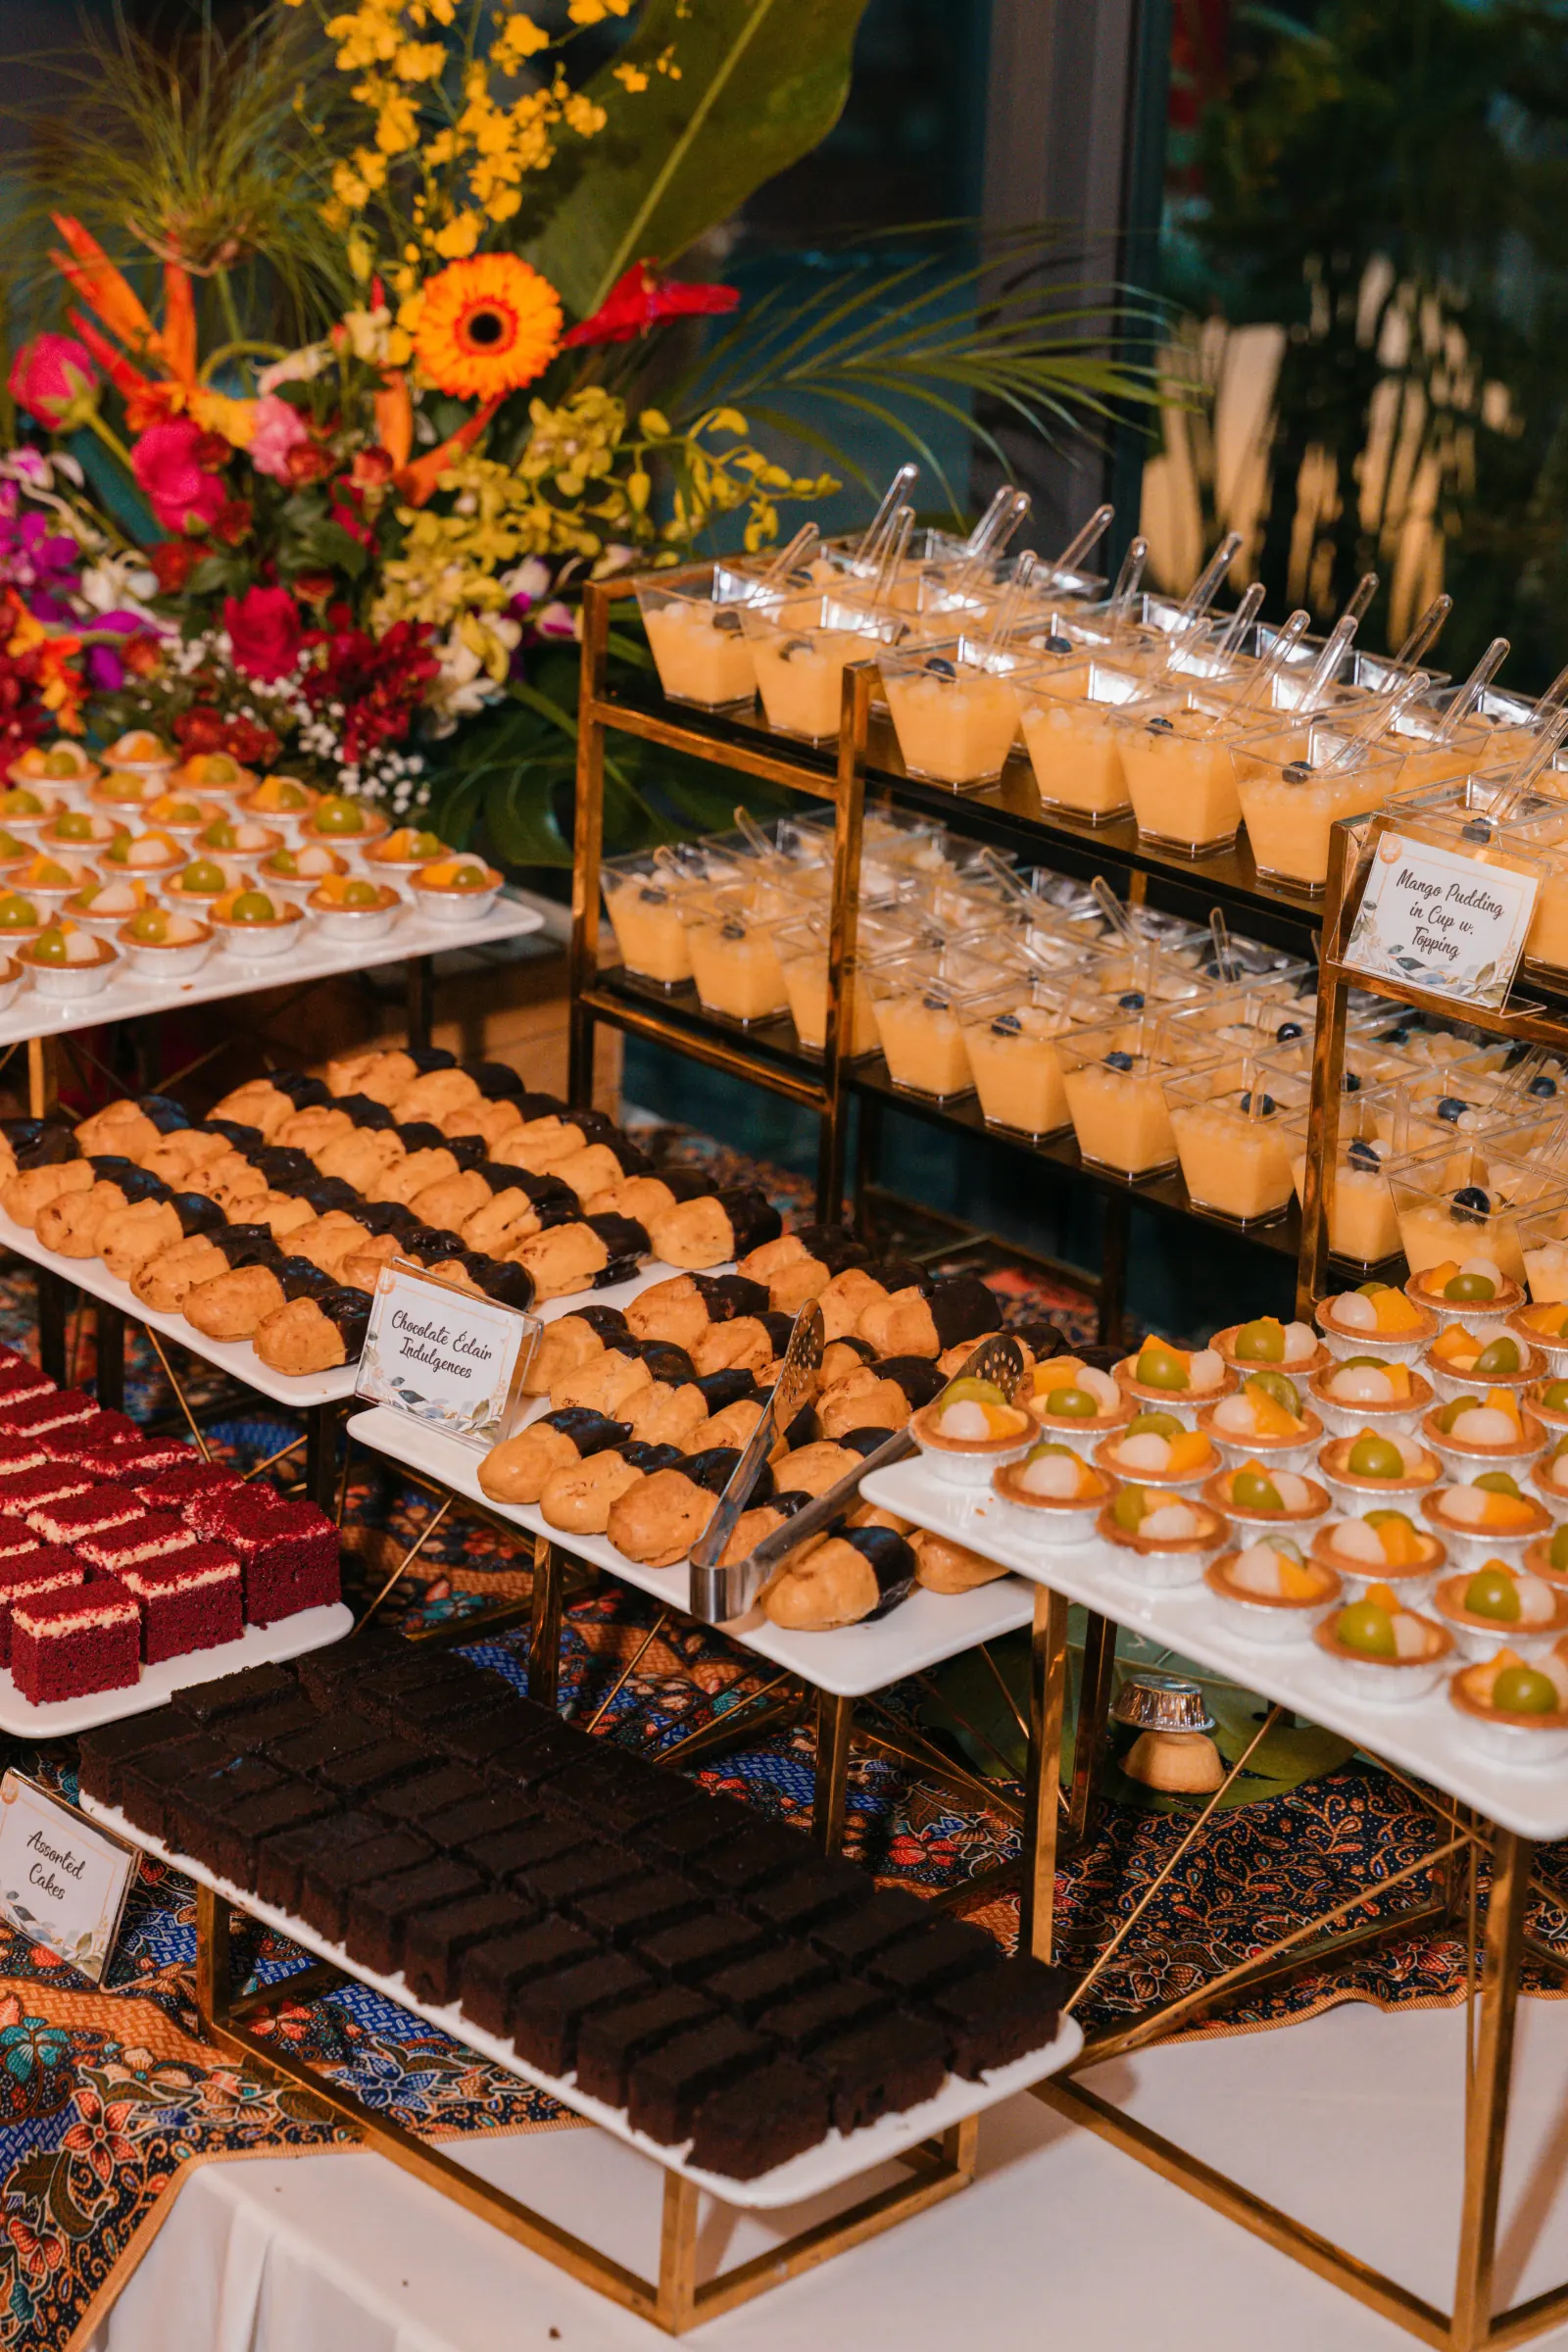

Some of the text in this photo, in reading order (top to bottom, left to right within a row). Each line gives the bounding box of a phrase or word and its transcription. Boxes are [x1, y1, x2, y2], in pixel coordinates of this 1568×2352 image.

[1396, 868, 1504, 920] Mango Pudding
[1409, 902, 1424, 919] in
[1427, 906, 1454, 931] Cup
[1411, 926, 1459, 959] Topping
[391, 1309, 492, 1360] Chocolate Éclair
[399, 1336, 472, 1379] Indulgences
[26, 1830, 86, 1881] Assorted
[28, 1862, 66, 1900] Cakes
